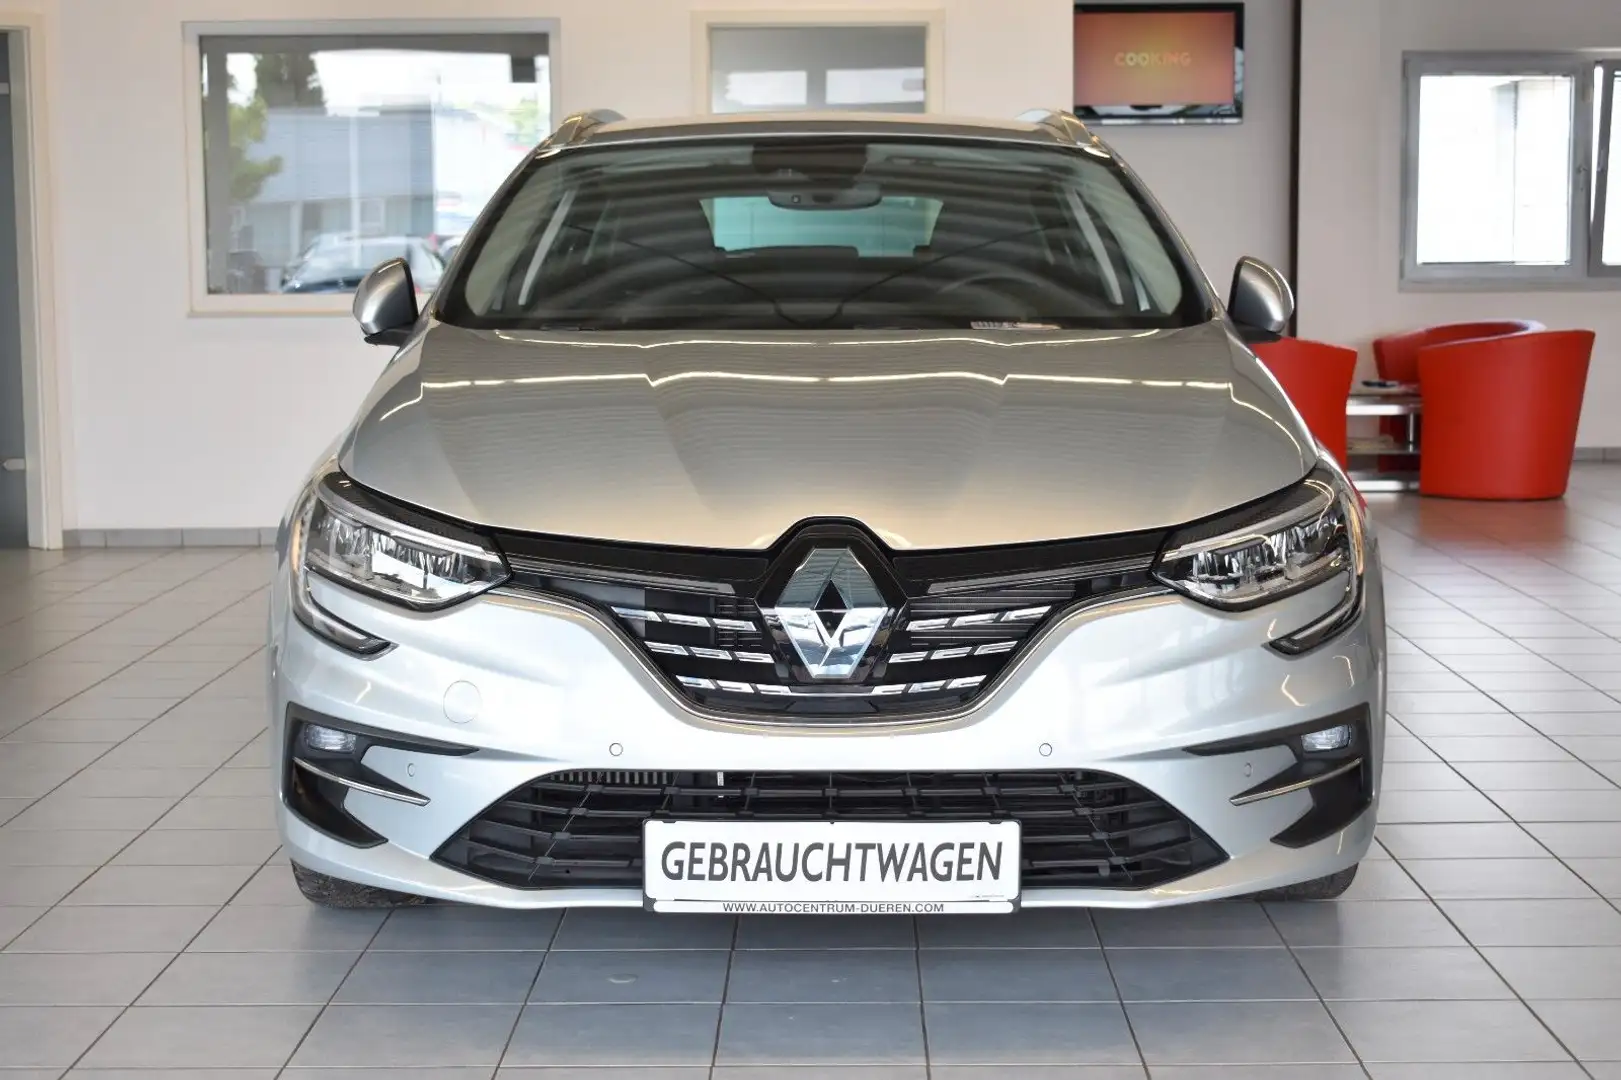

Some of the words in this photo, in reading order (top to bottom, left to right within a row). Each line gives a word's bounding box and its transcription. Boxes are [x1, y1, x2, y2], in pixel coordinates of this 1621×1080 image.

[1114, 52, 1192, 67] COOKING
[661, 841, 1003, 882] GEBRAUCHTWAGEN
[722, 902, 944, 914] WWW.AUTOCENTRUM-DUEREN.COM
